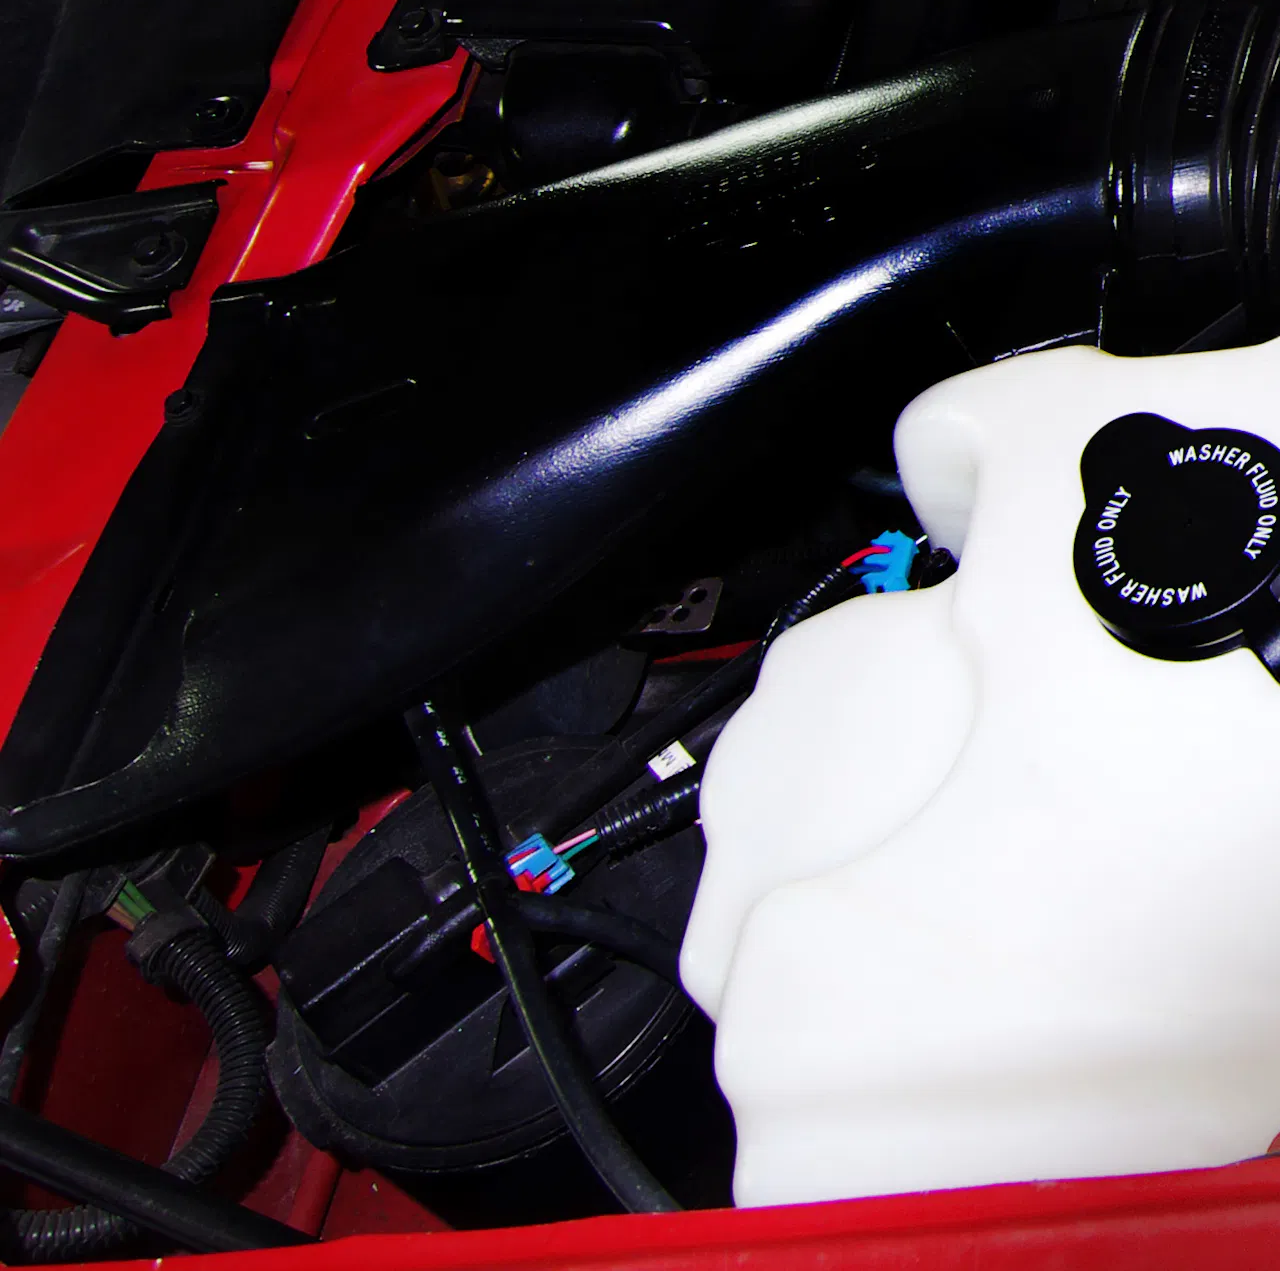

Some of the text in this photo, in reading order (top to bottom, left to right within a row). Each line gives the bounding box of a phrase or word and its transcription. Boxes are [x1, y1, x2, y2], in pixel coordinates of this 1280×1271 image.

[1093, 485, 1208, 608] WASHER FLUID ONLY
[1168, 443, 1279, 560] WASHER FLUID ONLY
